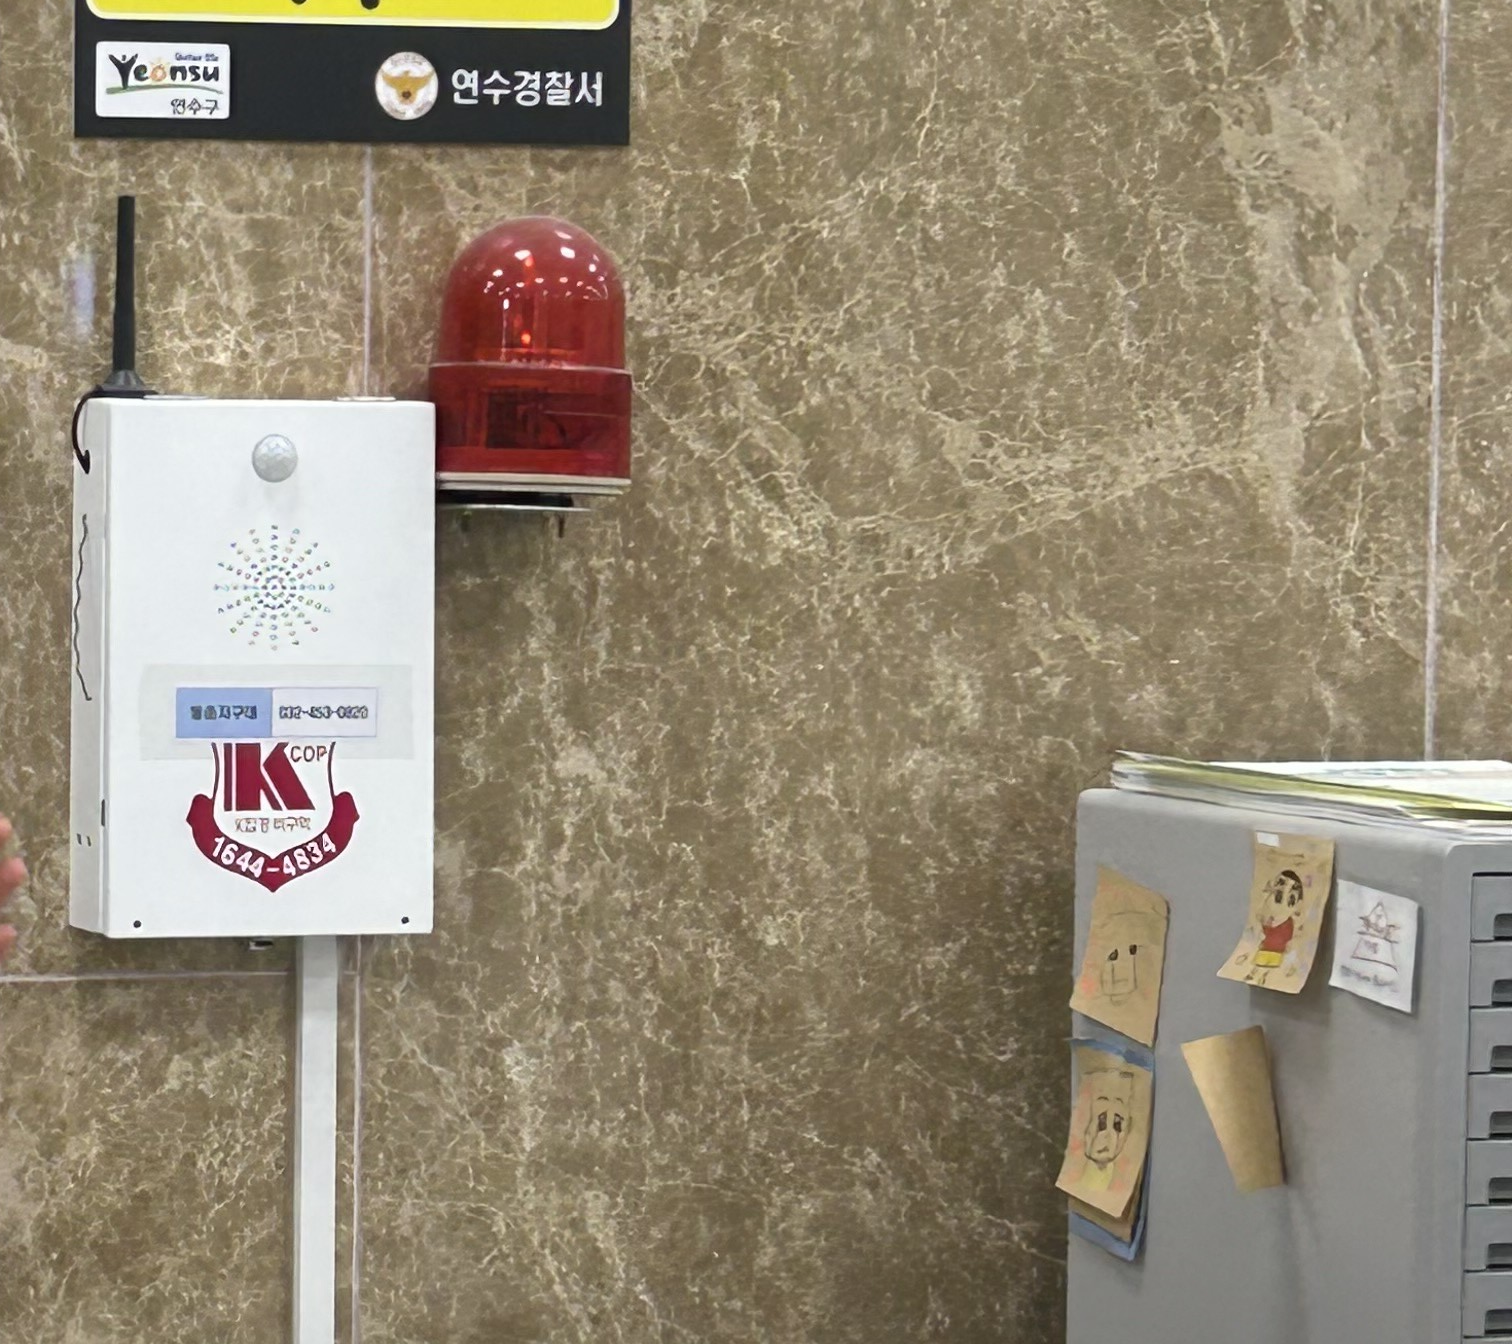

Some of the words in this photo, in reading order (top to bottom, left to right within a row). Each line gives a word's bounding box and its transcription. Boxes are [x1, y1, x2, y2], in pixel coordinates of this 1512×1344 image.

[108, 53, 220, 90] Yeonsu
[451, 68, 603, 107] 연수경찰서
[290, 745, 327, 762] COP
[212, 832, 336, 878] 1644-4834
